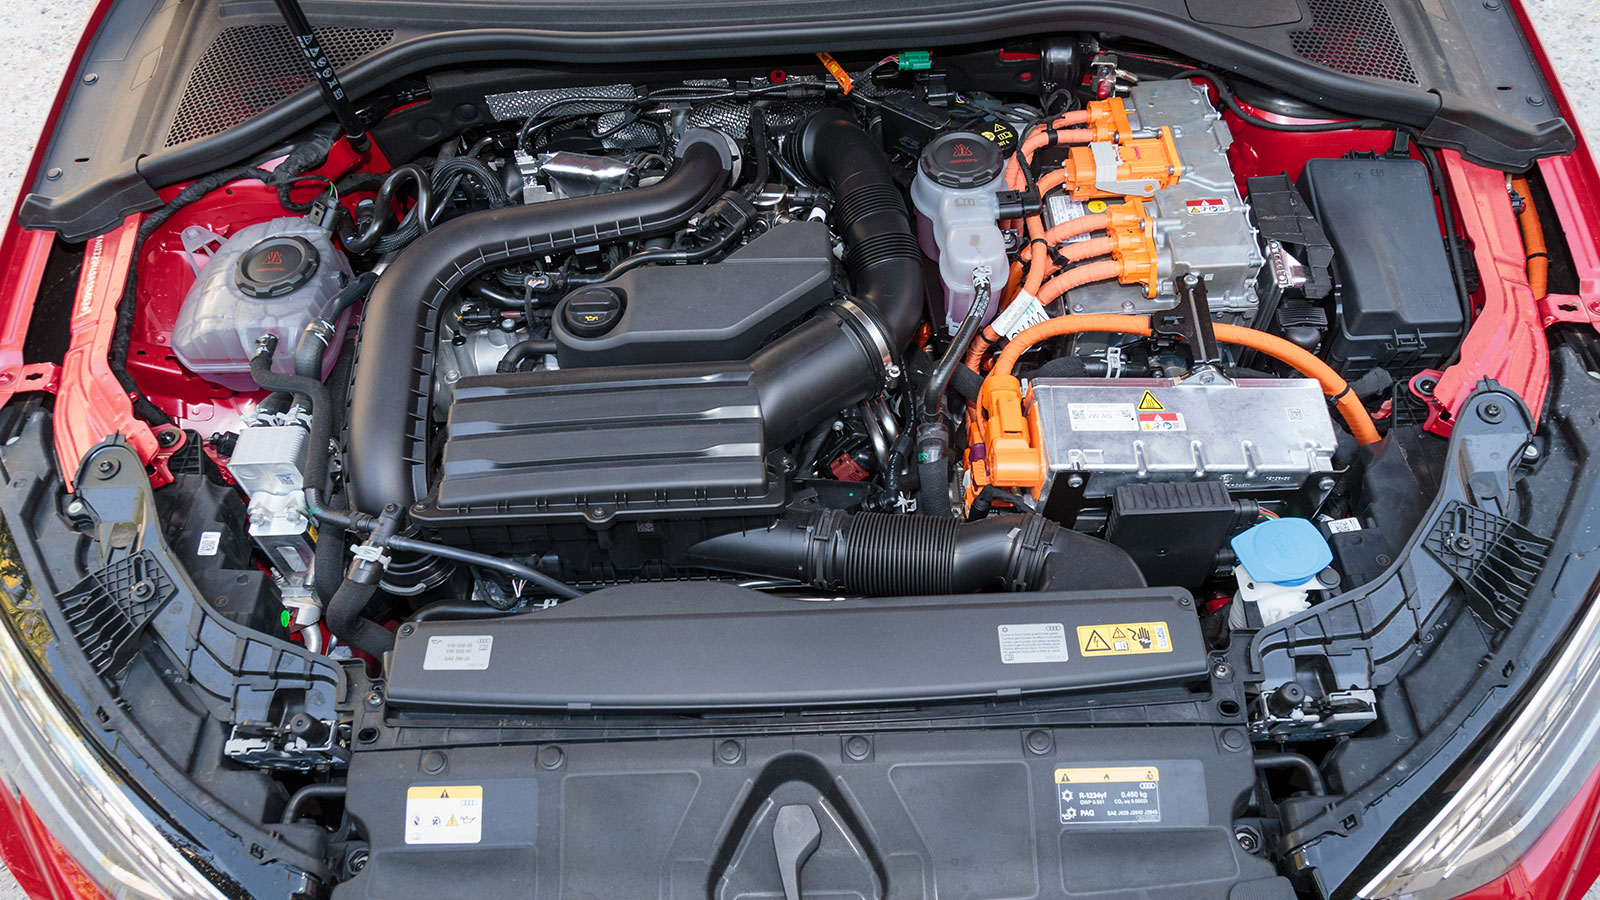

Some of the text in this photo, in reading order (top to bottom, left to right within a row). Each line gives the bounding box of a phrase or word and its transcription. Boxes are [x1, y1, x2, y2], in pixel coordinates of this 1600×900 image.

[1079, 791, 1148, 800] R-1234yf 0.450 kg
